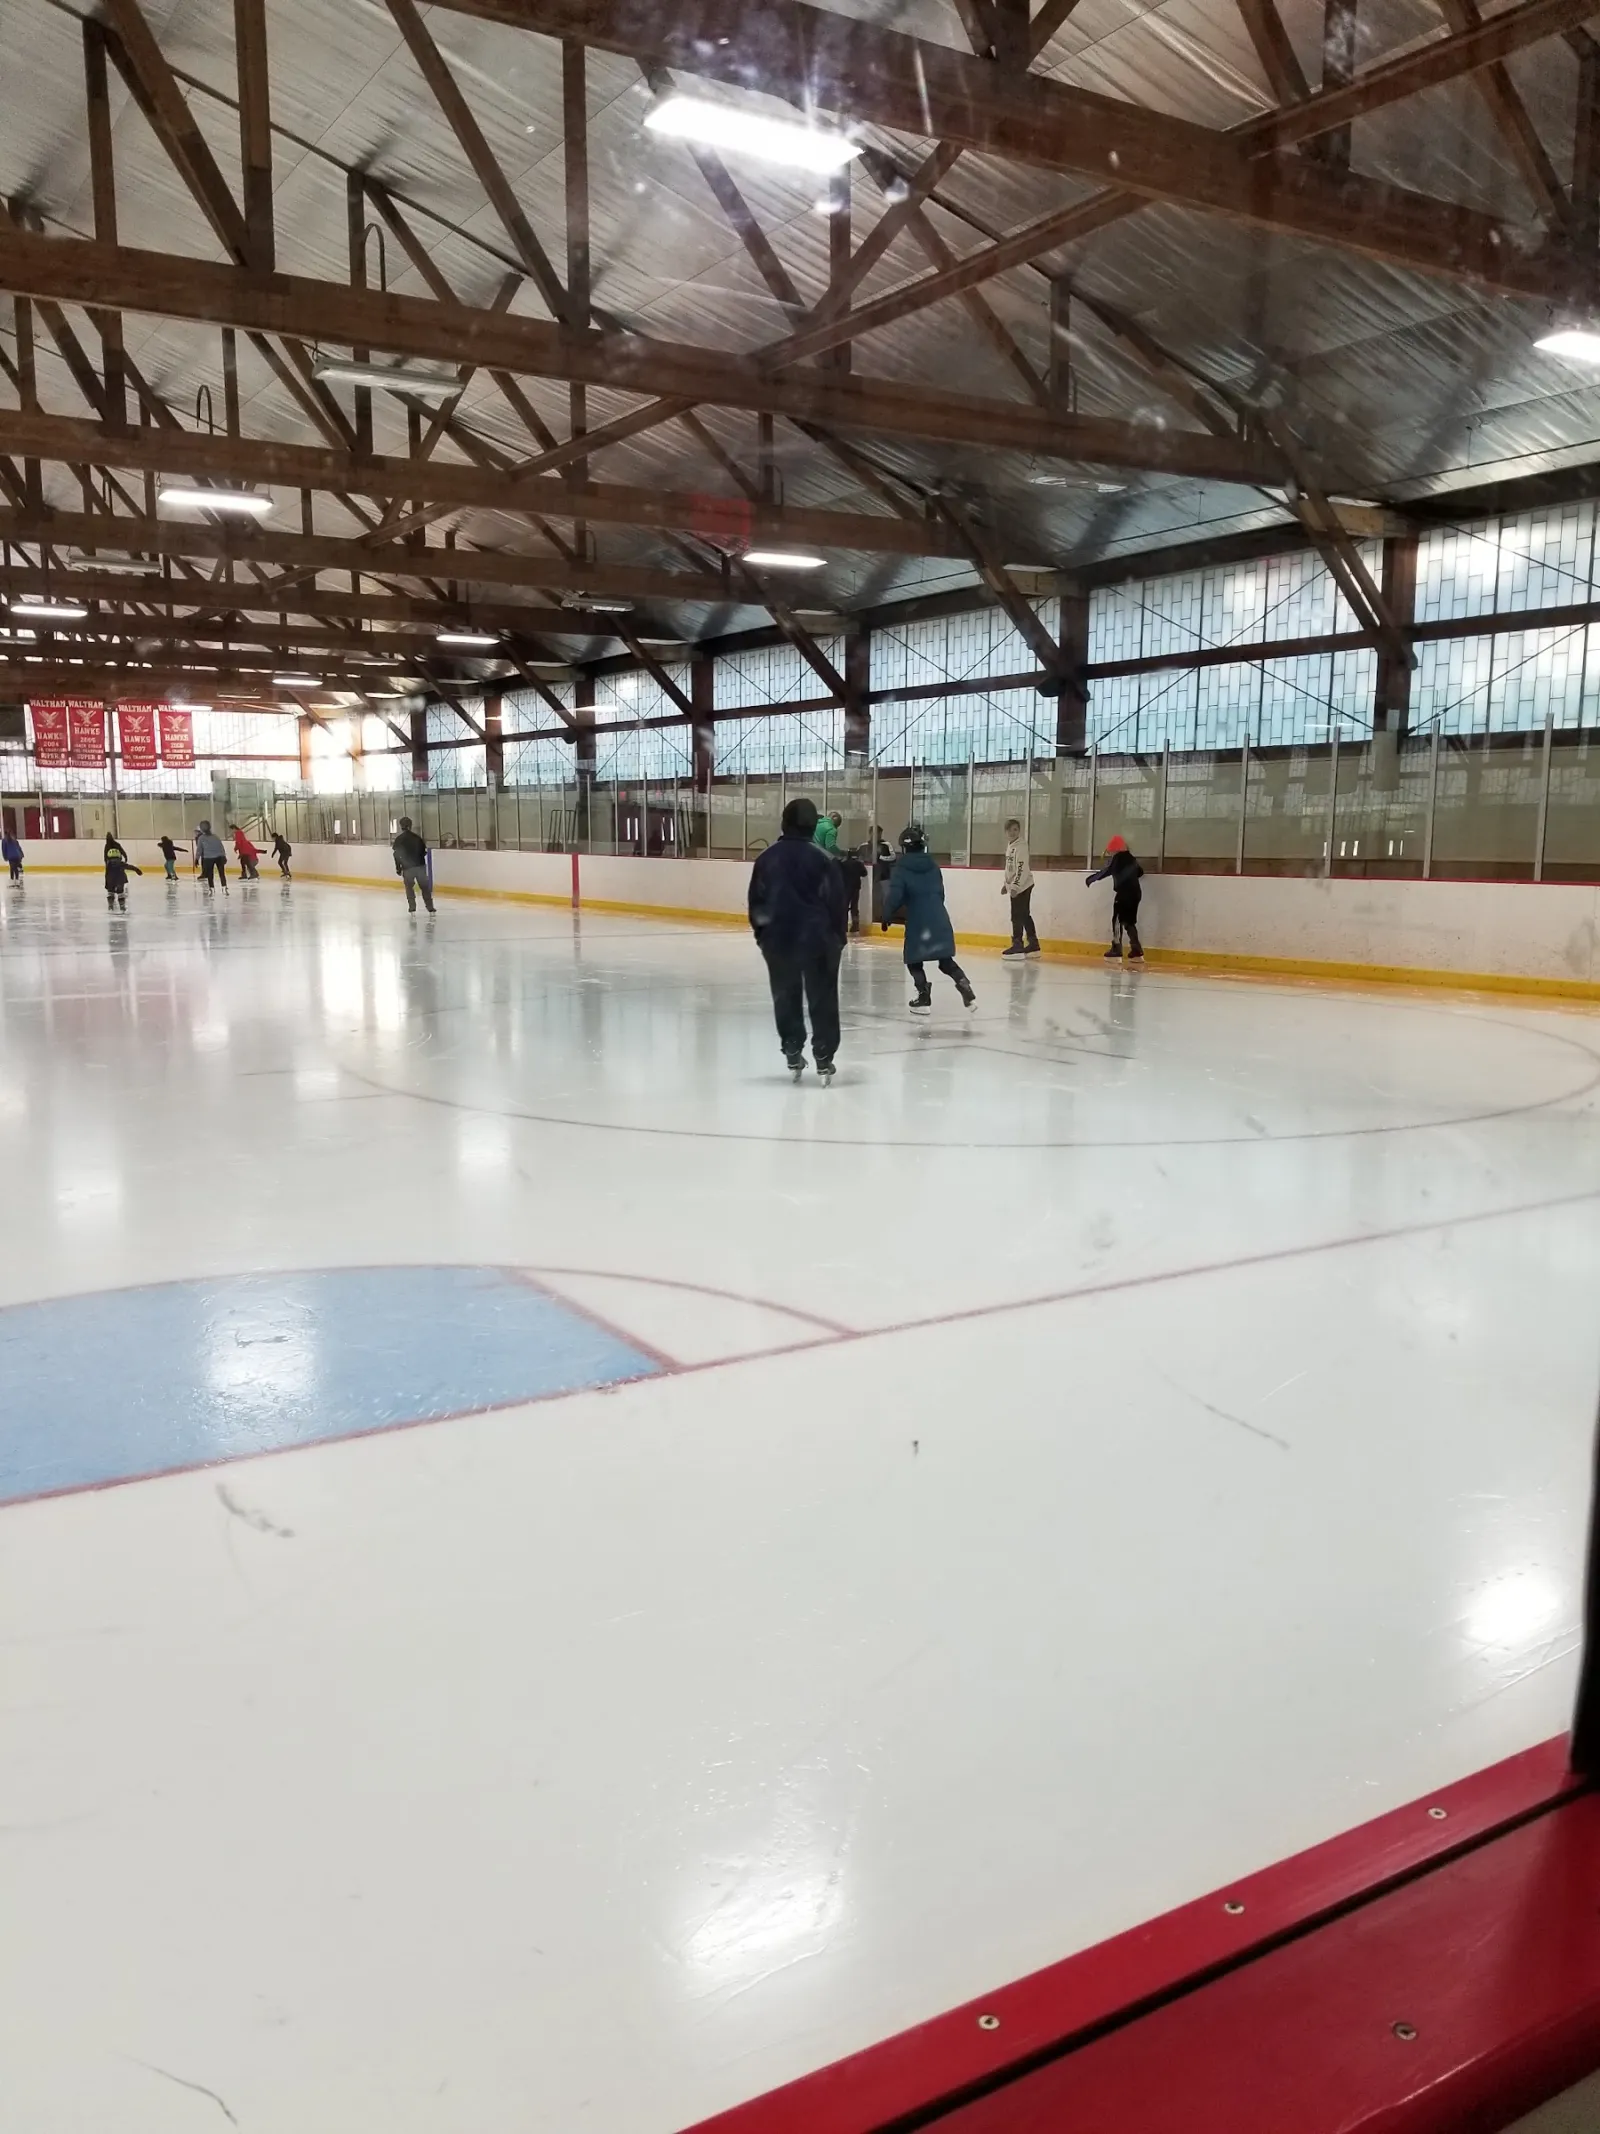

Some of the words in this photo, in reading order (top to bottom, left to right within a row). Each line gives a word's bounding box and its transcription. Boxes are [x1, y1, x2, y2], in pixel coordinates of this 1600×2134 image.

[30, 699, 66, 707] WALTHAM
[68, 700, 103, 708] WALTHAM
[74, 727, 100, 735] HAWKS
[124, 735, 151, 743] HAWKS
